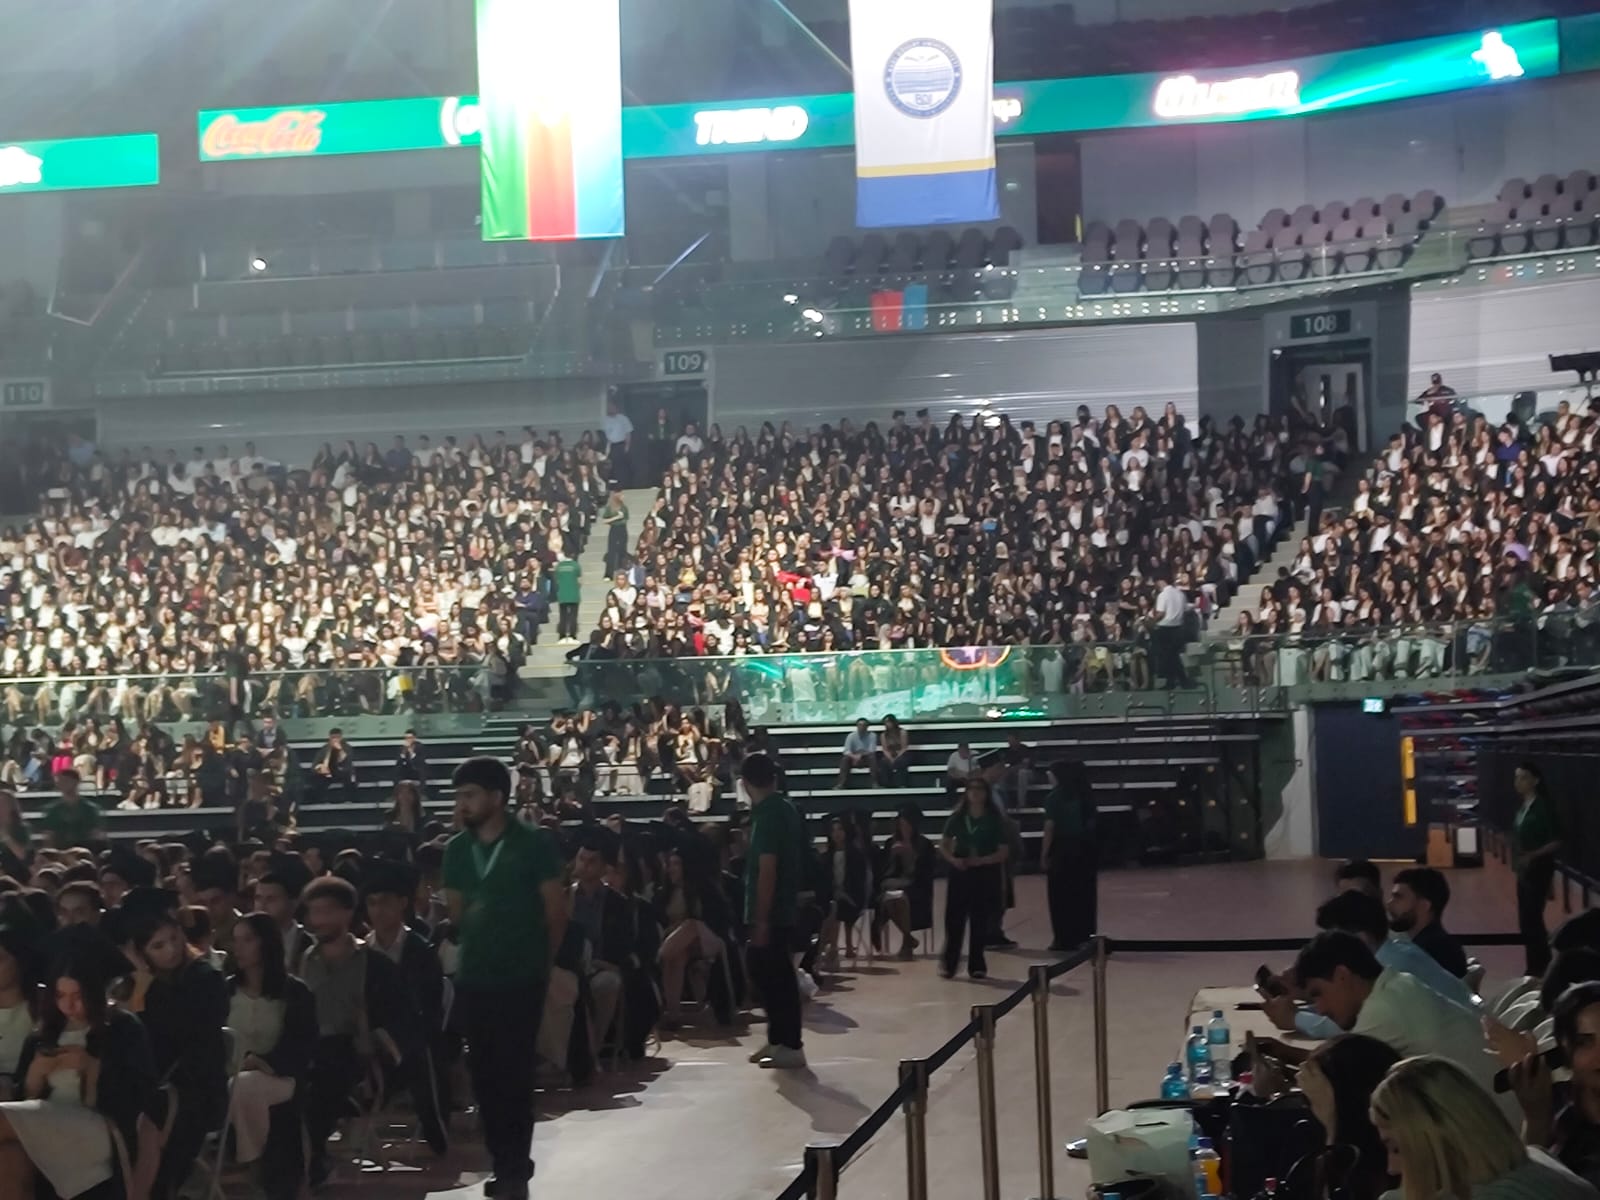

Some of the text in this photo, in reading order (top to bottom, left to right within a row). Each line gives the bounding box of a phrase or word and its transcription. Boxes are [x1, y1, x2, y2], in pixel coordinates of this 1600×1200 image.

[1304, 314, 1337, 334] 108
[667, 354, 701, 371] 109
[7, 384, 41, 401] 110
